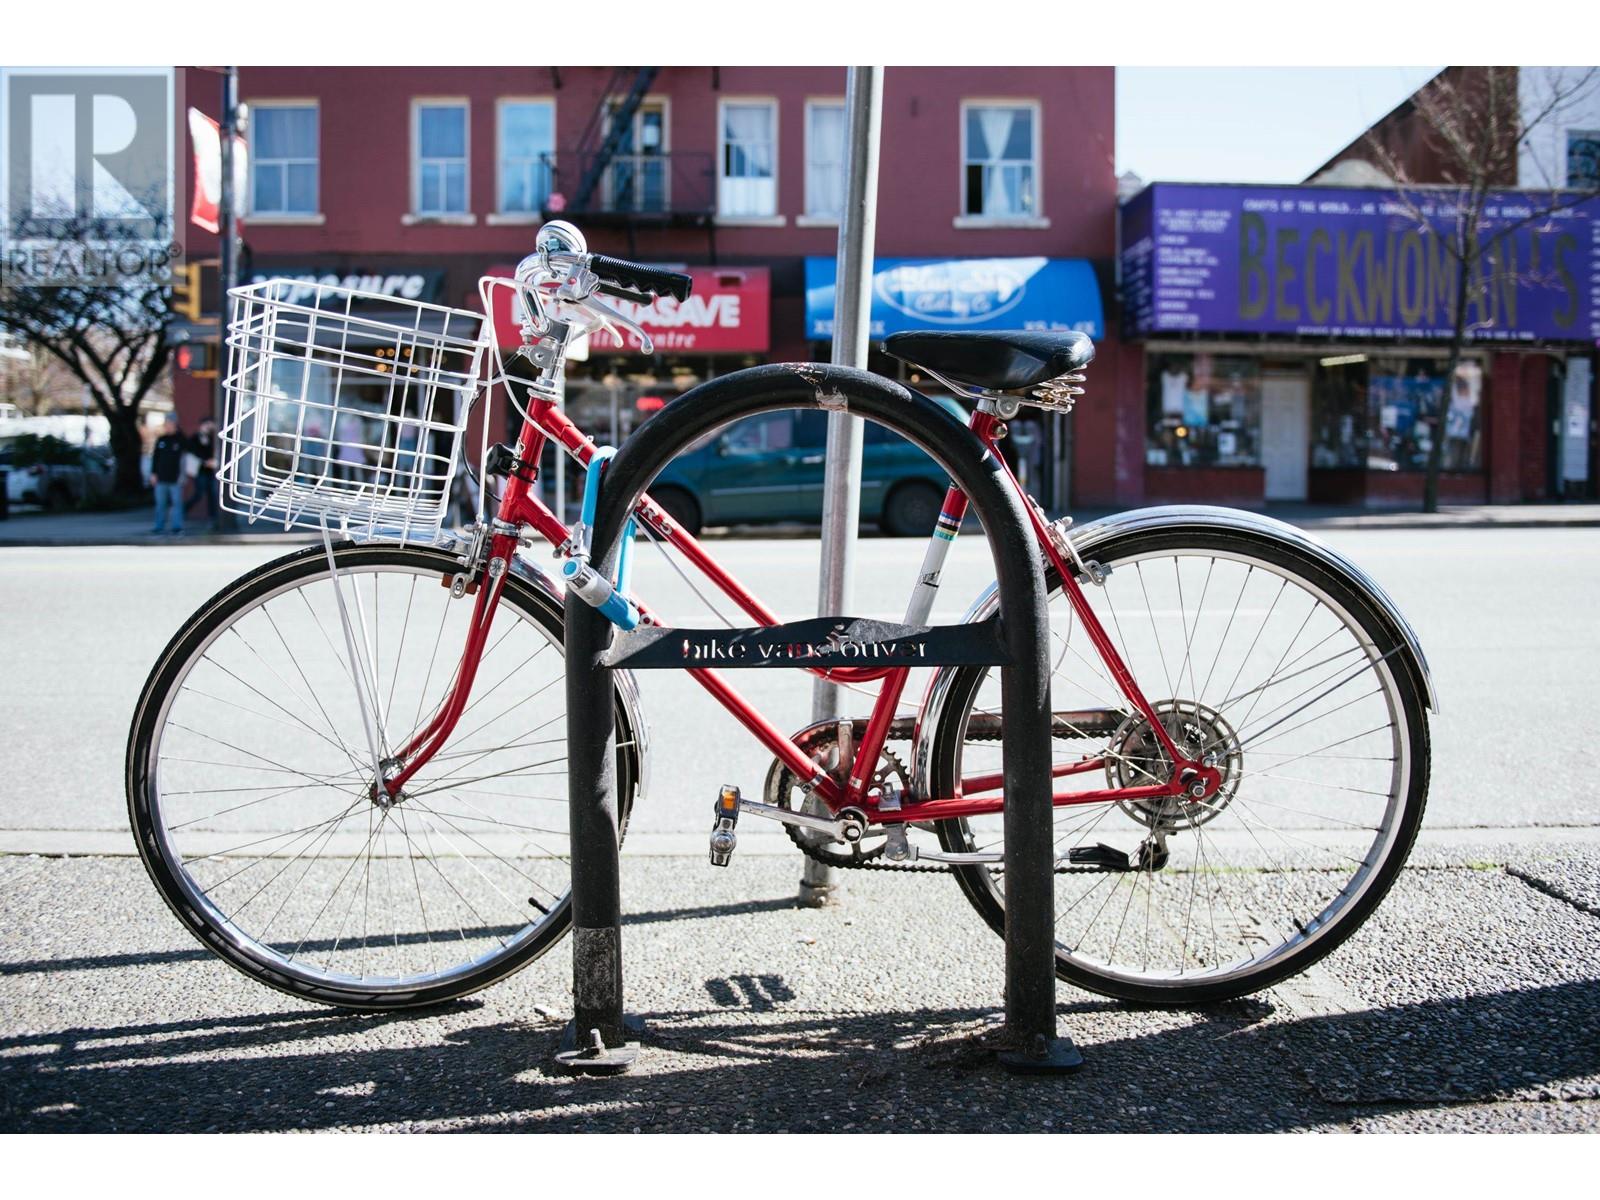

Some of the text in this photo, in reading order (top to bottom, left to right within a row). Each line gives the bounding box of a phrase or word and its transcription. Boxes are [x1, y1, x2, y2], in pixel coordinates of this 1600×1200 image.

[1238, 210, 1579, 330] BECKWOMAN'S
[627, 331, 696, 348] Cntre
[682, 639, 926, 659] bike vancouver
